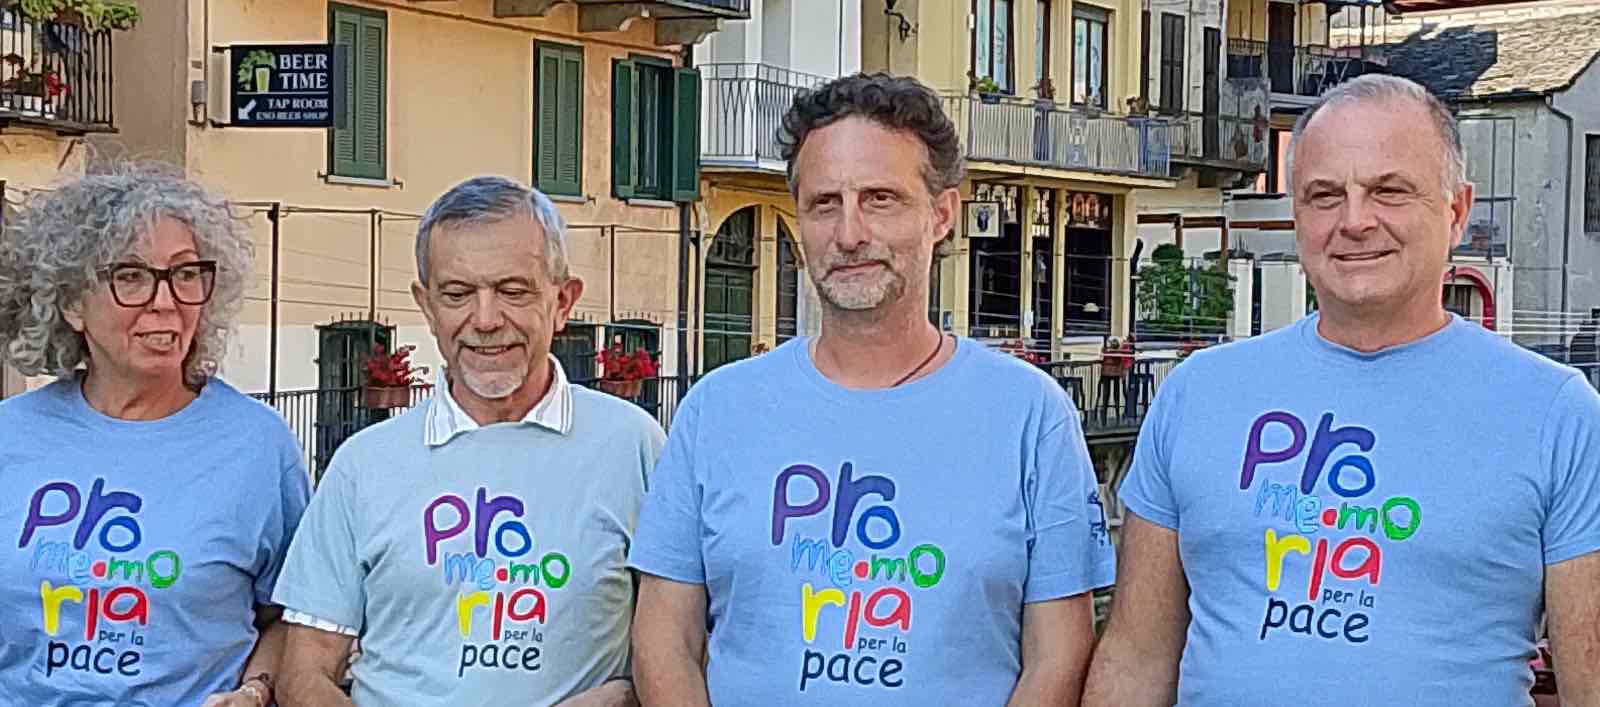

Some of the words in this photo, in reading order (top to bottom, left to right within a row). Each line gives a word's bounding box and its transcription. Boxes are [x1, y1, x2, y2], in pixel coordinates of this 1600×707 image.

[279, 53, 328, 70] BEER
[279, 72, 328, 89] TIME
[267, 98, 290, 109] TAP
[292, 98, 328, 109] ROOM
[1322, 589, 1354, 604] per
[1359, 590, 1374, 608] la
[1260, 597, 1369, 643] pace
[98, 628, 125, 643] per
[131, 629, 144, 645] la
[504, 627, 528, 643] per
[531, 627, 543, 643] la
[857, 636, 887, 650] per
[892, 636, 906, 653] la
[46, 639, 141, 677] pace
[458, 644, 541, 678] pace
[799, 648, 904, 692] pace
